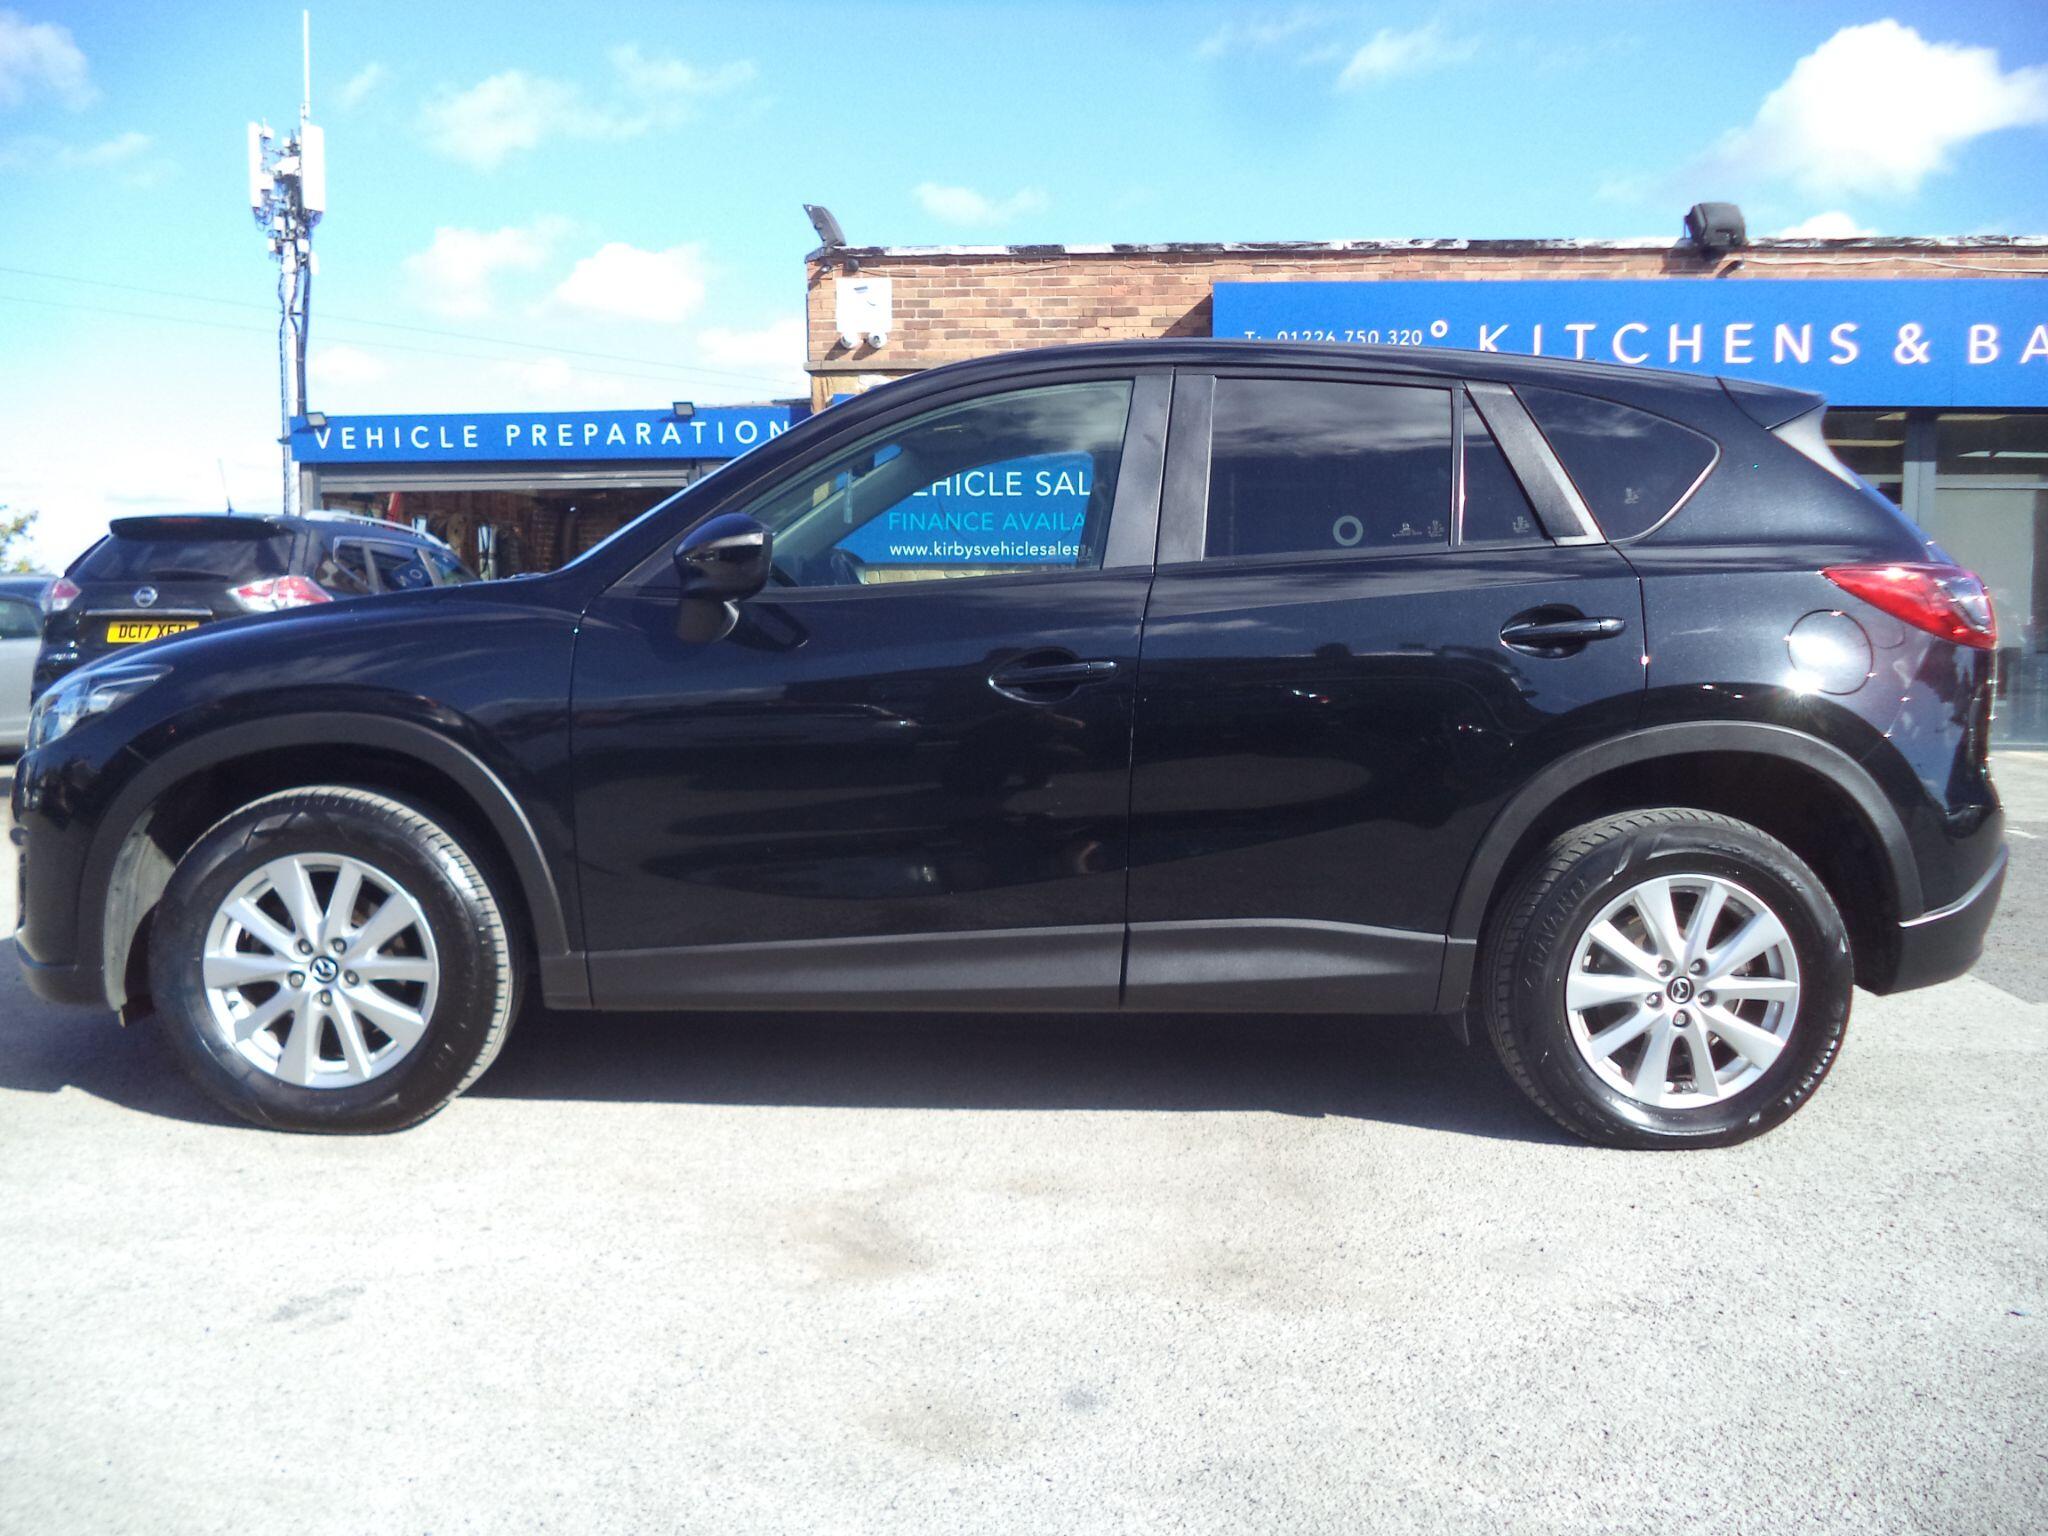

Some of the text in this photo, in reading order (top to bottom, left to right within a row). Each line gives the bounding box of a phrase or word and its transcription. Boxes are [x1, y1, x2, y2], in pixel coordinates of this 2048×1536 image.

[1345, 329, 1379, 344] 750
[1387, 329, 1422, 346] 320
[1479, 322, 2048, 365] KITCHENS & BA
[315, 420, 790, 450] VEHICLE PREPARATION
[913, 471, 1091, 497] HICLE SAL
[888, 511, 1086, 531] FINANCE AVAILA
[890, 541, 1080, 560] www.kirbysvehiclesales
[119, 624, 153, 639] DC17
